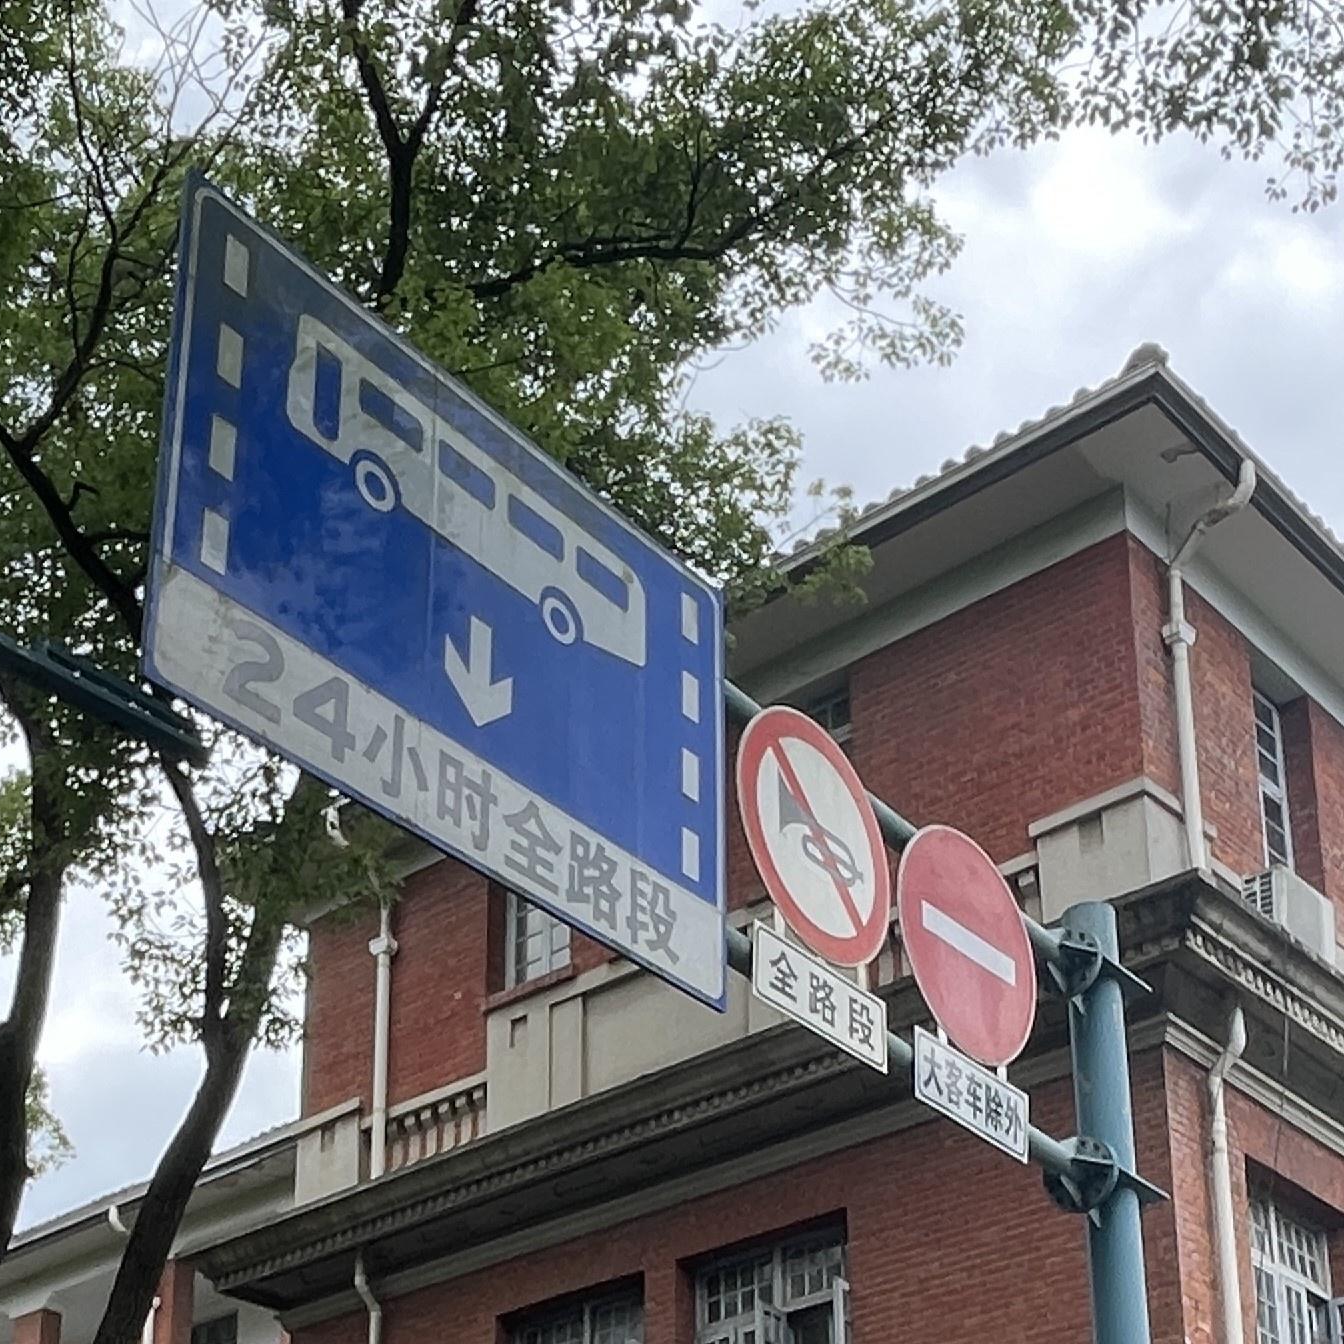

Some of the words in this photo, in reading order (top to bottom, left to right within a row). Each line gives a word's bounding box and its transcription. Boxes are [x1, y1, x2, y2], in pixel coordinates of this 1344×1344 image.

[221, 617, 681, 964] 24小时全路段
[768, 950, 875, 1052] 全路段
[922, 1046, 1023, 1144] 大客车除外
